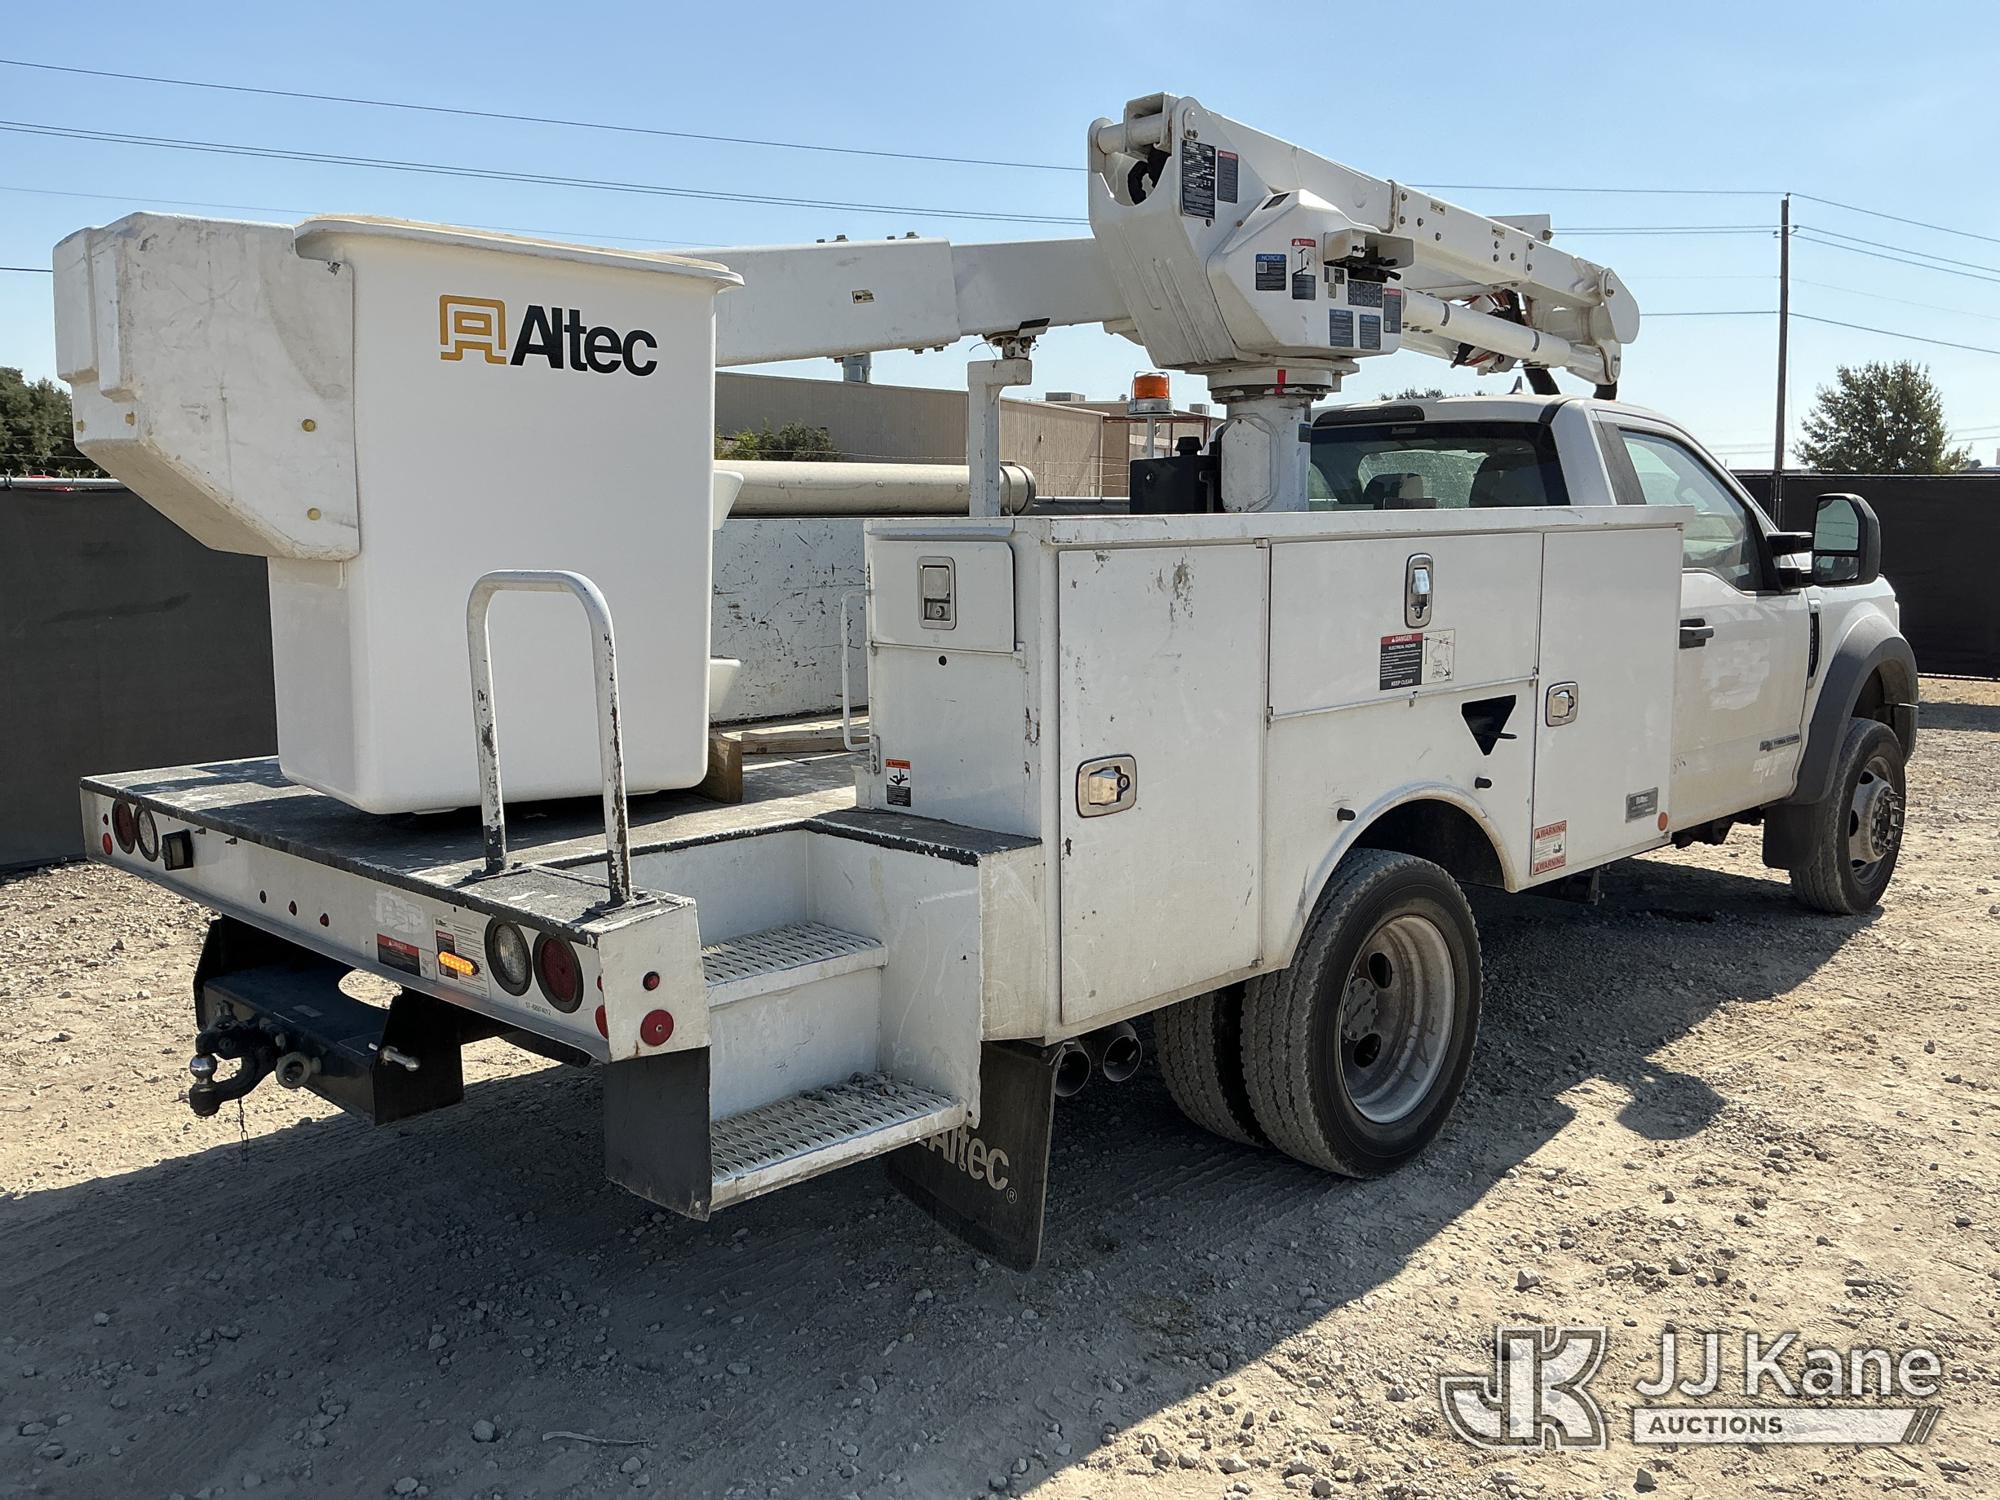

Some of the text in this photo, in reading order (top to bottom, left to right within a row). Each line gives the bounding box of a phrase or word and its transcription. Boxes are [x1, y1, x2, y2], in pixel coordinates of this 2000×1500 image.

[510, 305, 658, 377] Altec
[1540, 823, 1566, 838] WARNING
[1539, 855, 1566, 871] WARNING
